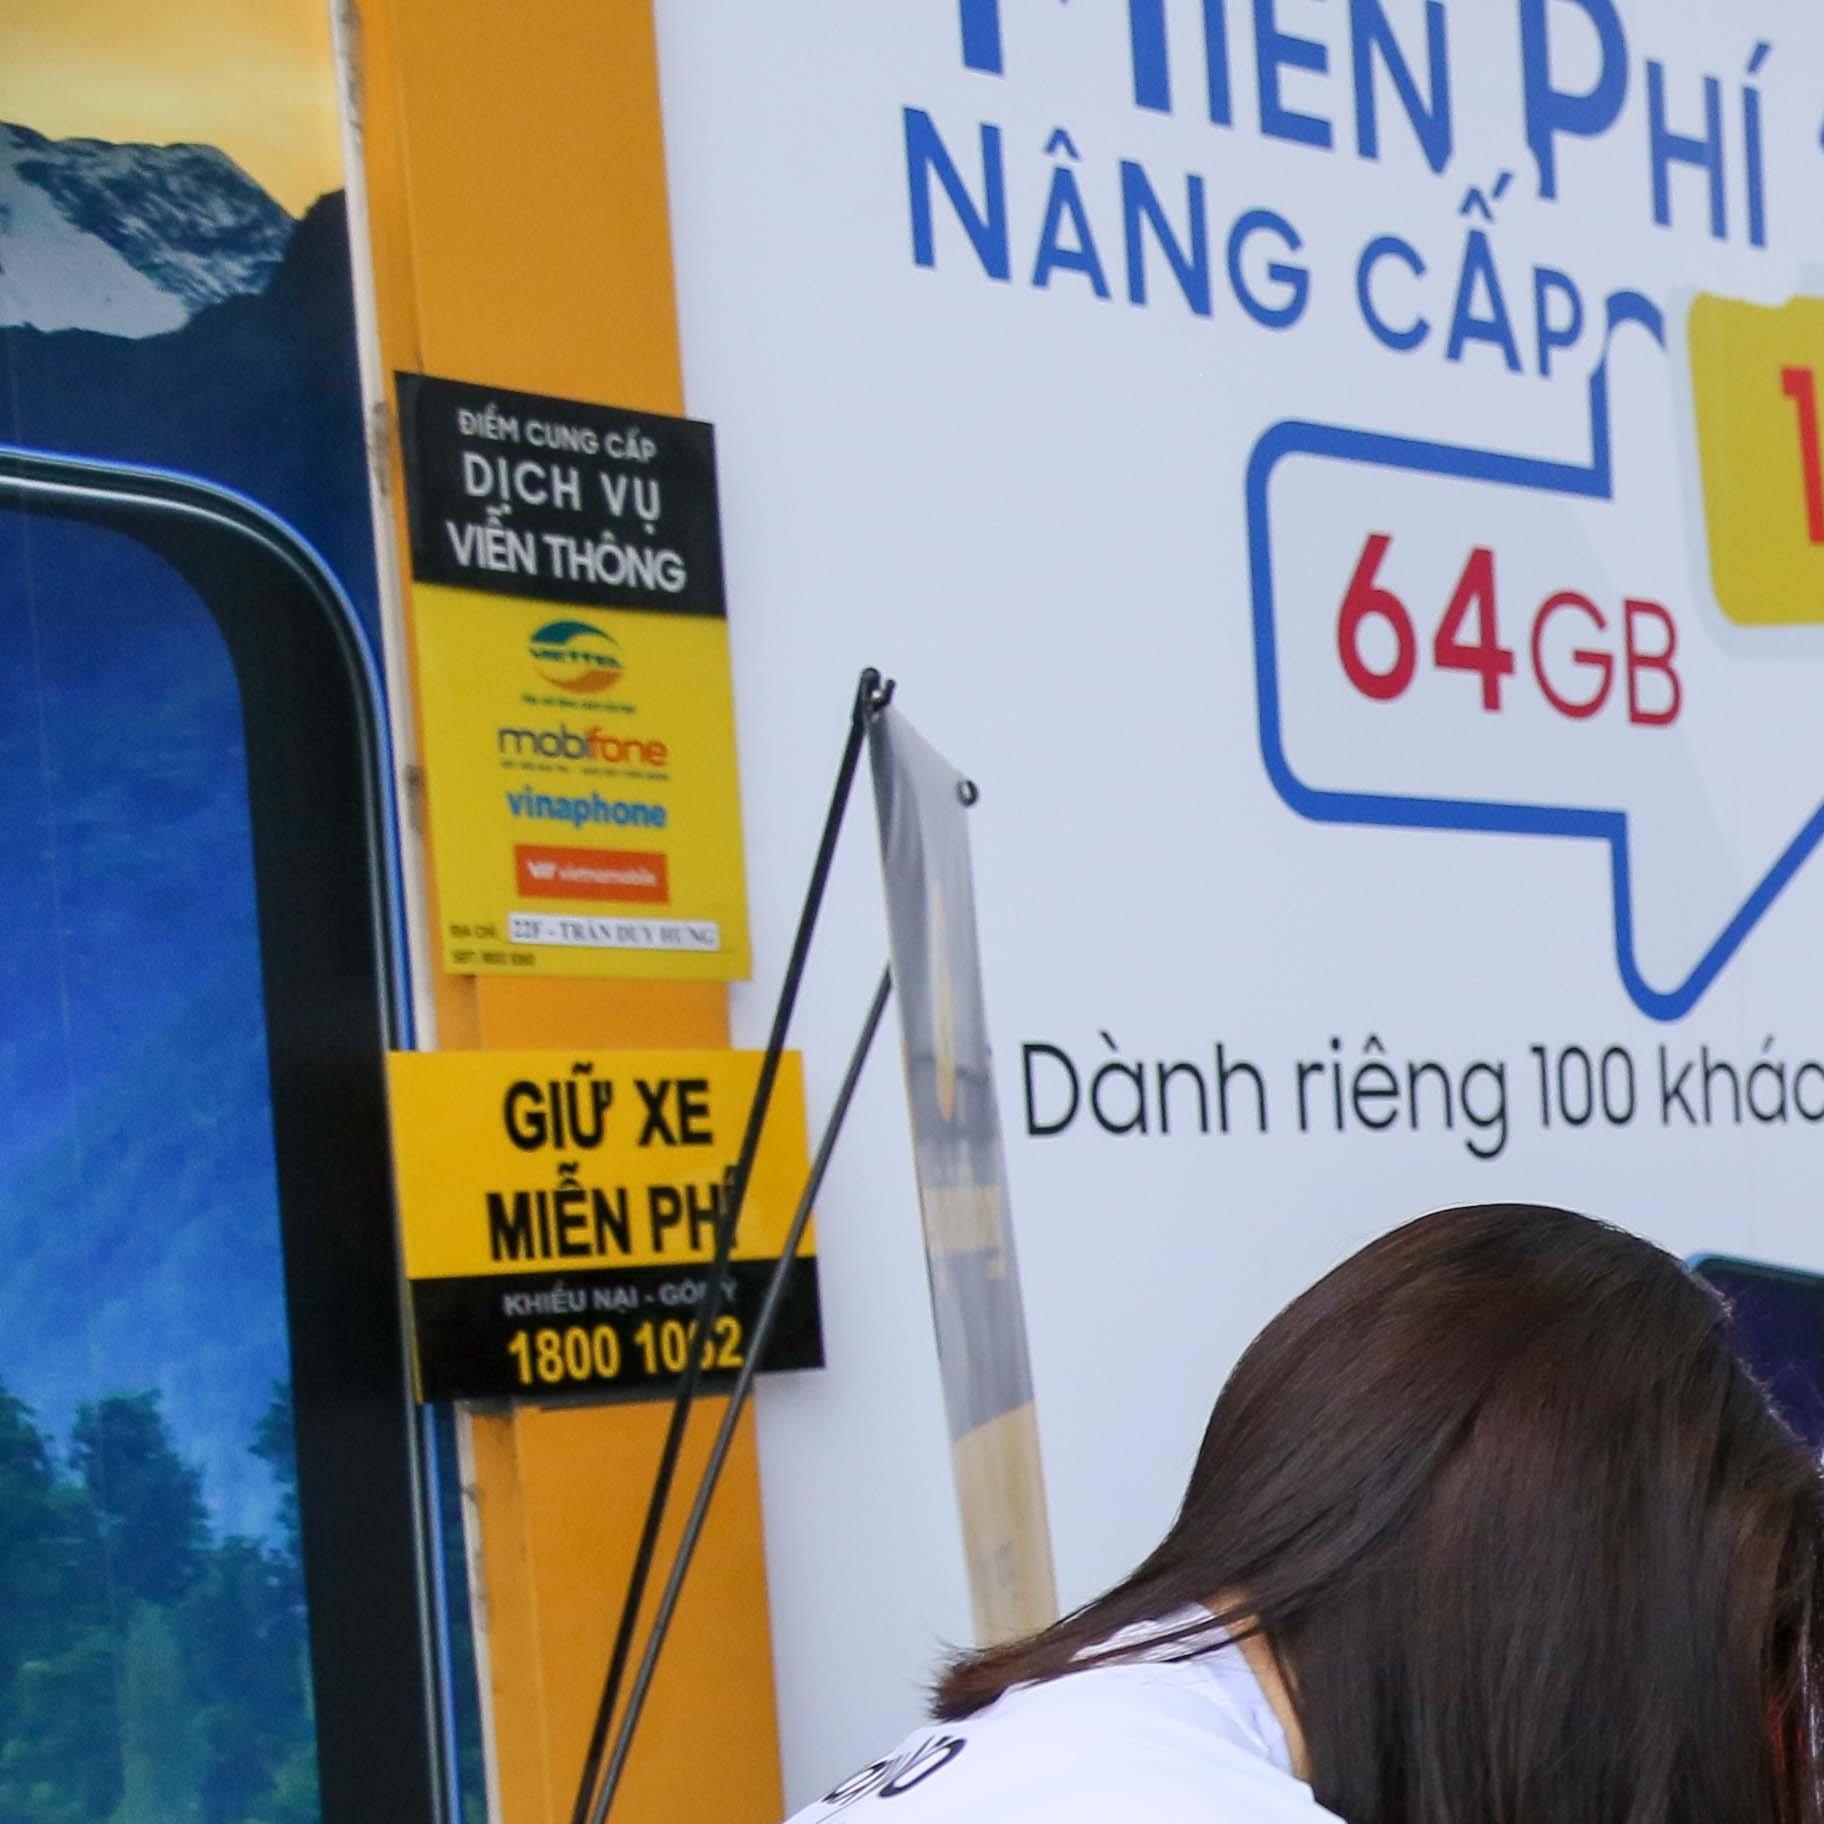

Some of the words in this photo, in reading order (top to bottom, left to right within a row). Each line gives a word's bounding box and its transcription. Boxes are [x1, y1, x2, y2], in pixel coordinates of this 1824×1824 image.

[1518, 0, 1771, 248] PHÍ
[902, 105, 1310, 330] NÂNG
[1356, 170, 1585, 378] CẤP
[457, 404, 519, 443] ĐIỂM
[526, 420, 600, 456] CUNG
[603, 427, 658, 463] CẤP
[463, 451, 583, 514] DỊCH
[601, 473, 662, 534] VỤ
[445, 504, 537, 576] VIỄN
[543, 525, 687, 595] THÔNG
[1337, 531, 1683, 728] 64GB
[498, 722, 669, 768] mobifone
[506, 785, 668, 829] vinaphone
[504, 1061, 614, 1152] GIỮ
[633, 1078, 715, 1148] XE
[1021, 1031, 1269, 1138] Dành
[1296, 1036, 1508, 1160] riêng
[1529, 1045, 1637, 1126] 100
[486, 1160, 633, 1263] MIỄN
[504, 1280, 587, 1318] KHIẾU
[594, 1286, 639, 1322] NẠI
[508, 1324, 621, 1386] 1800
